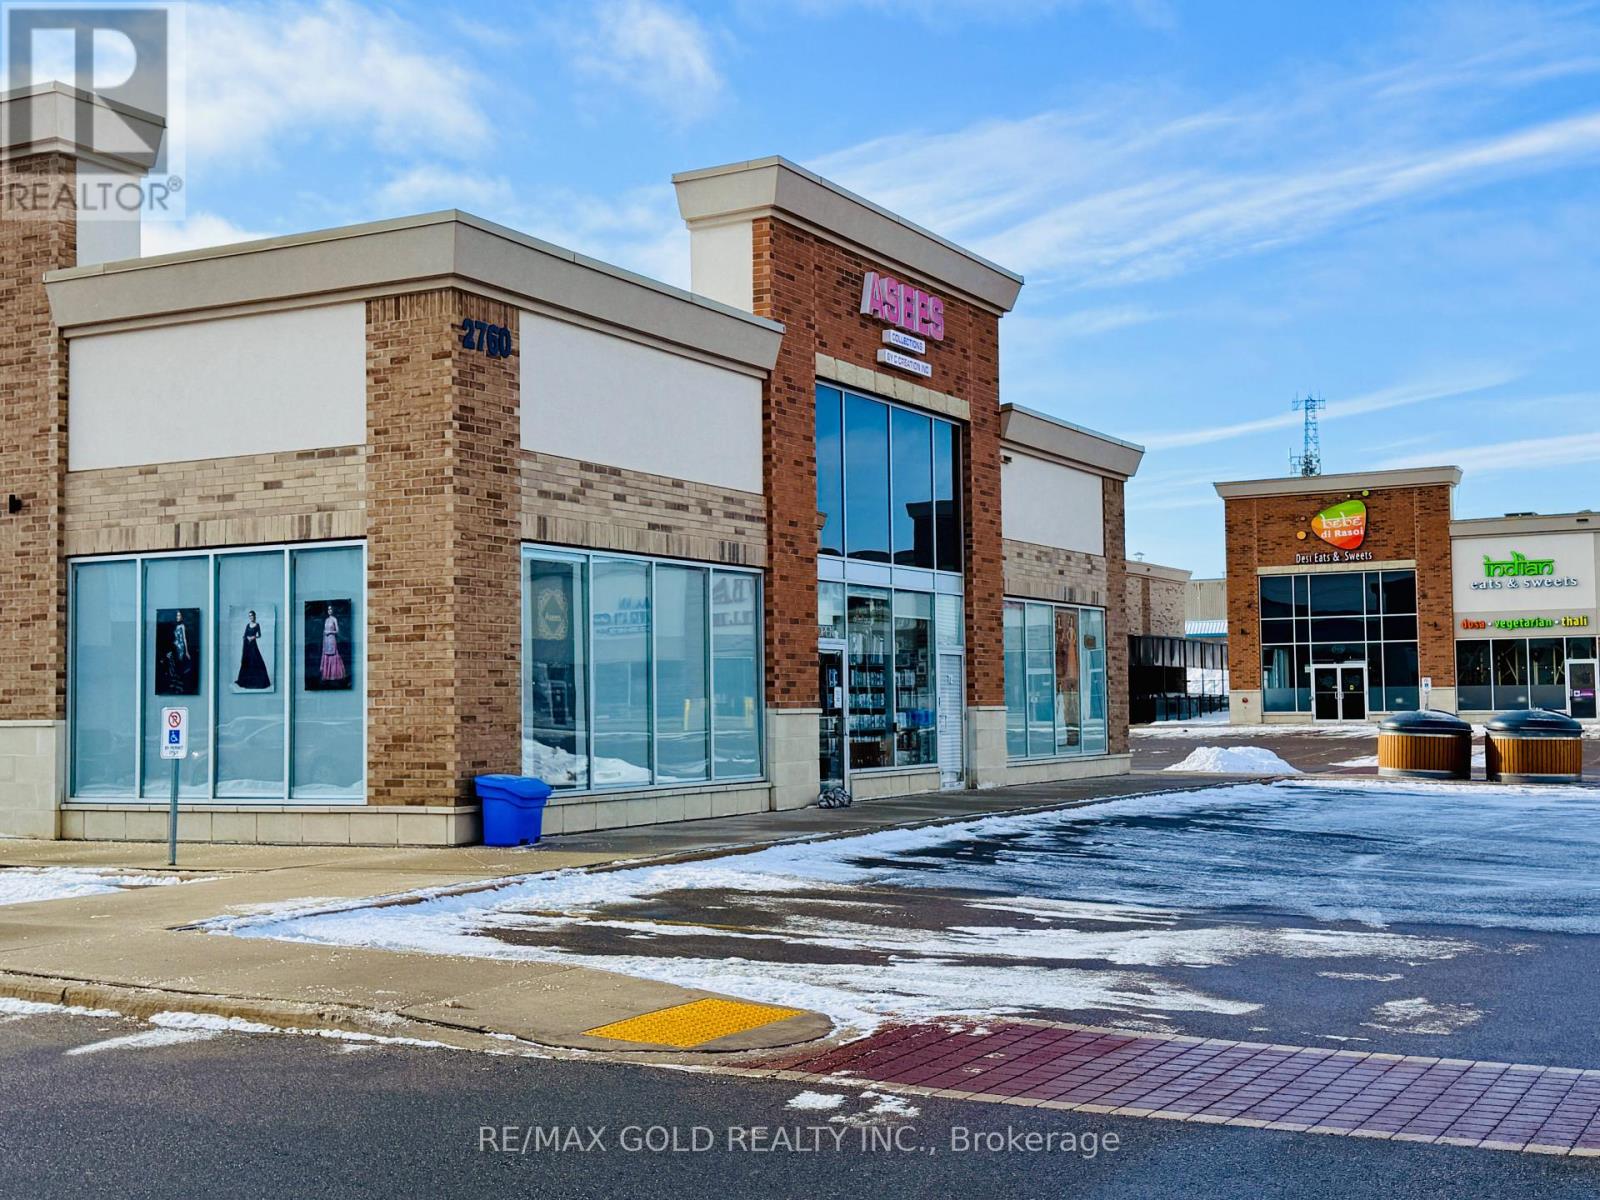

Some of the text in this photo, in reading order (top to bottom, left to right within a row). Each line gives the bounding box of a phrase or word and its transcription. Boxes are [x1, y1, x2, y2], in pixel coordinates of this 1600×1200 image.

[860, 271, 945, 341] ASEES
[462, 317, 512, 358] 2760
[891, 332, 923, 351] COLLECTIONS
[1320, 526, 1364, 539] di Rasoi
[1295, 551, 1373, 563] Desi Eats & Sweets
[1482, 550, 1555, 577] indian
[1470, 576, 1578, 589] eats & sweets
[1461, 615, 1588, 630] dosa vegetarian thali
